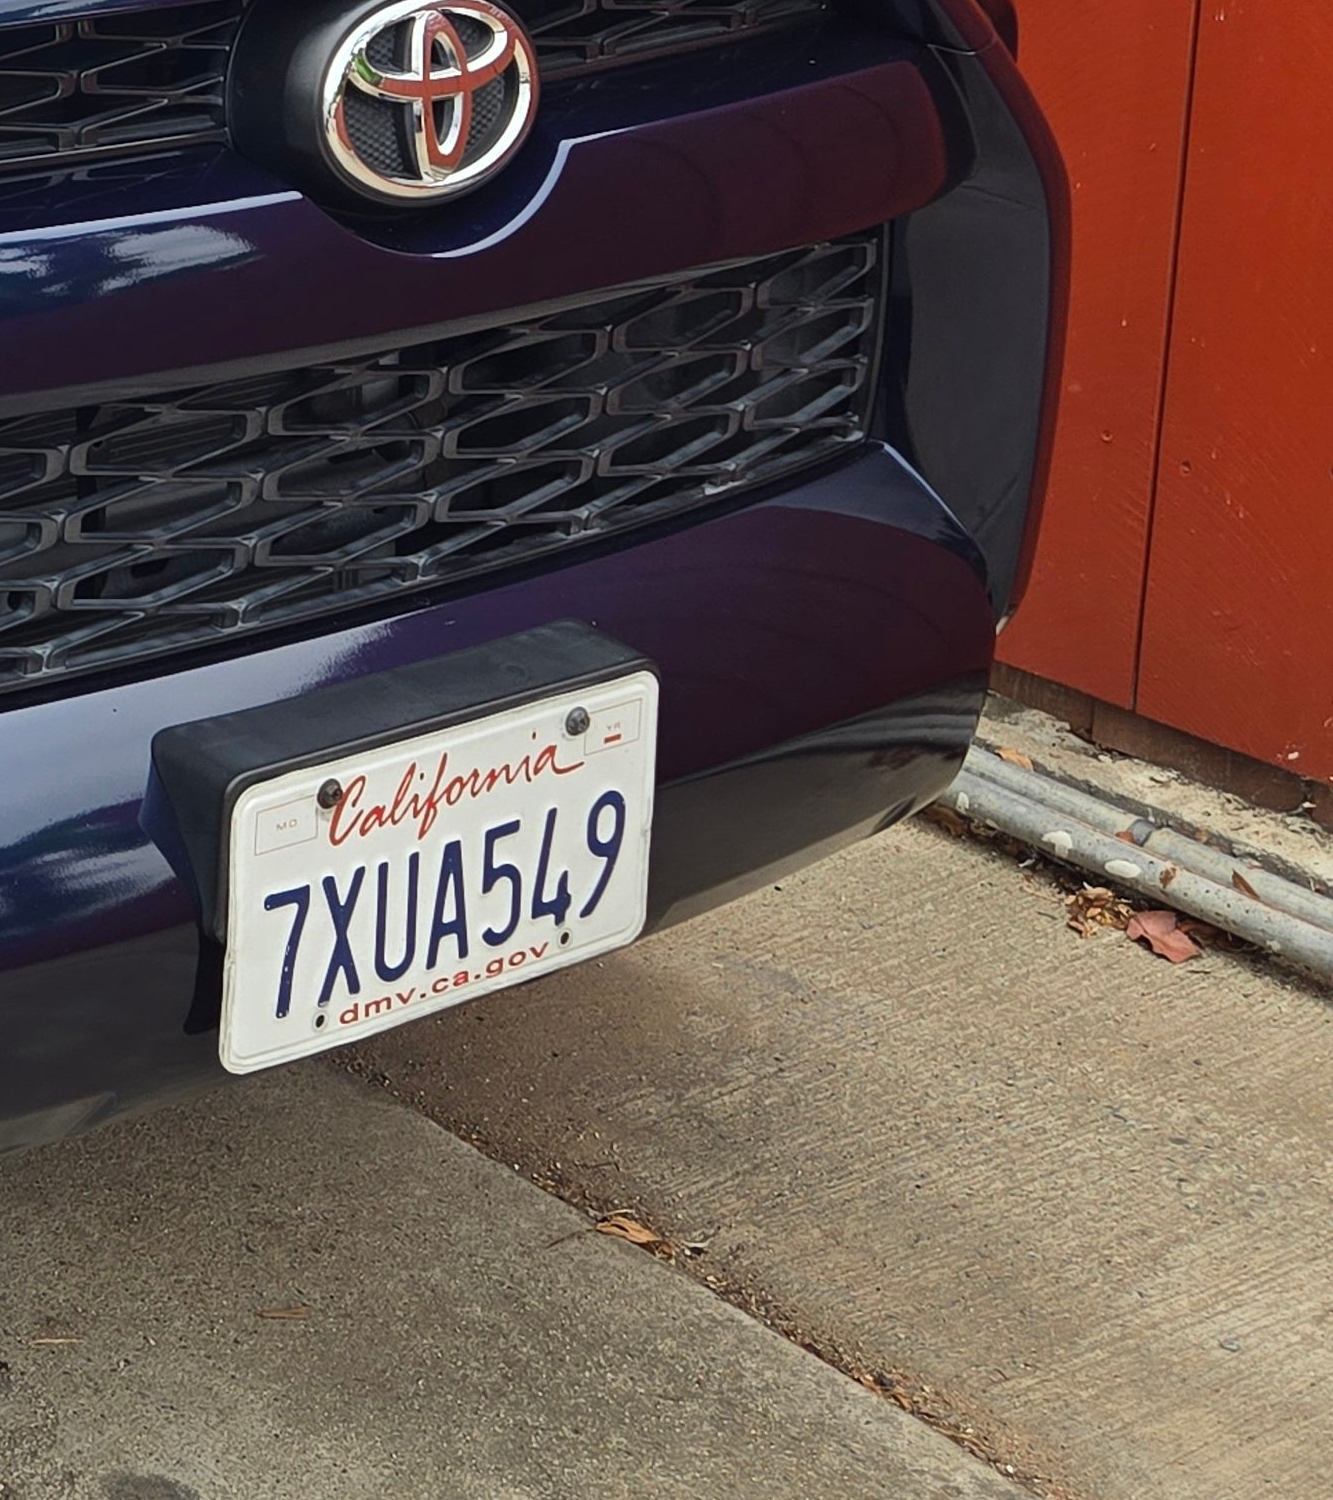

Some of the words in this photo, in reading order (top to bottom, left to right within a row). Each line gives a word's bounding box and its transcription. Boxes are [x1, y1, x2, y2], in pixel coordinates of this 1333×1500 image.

[328, 730, 585, 847] California
[263, 789, 627, 1020] 7XUA549
[338, 941, 551, 1026] dmv.ca.gov
